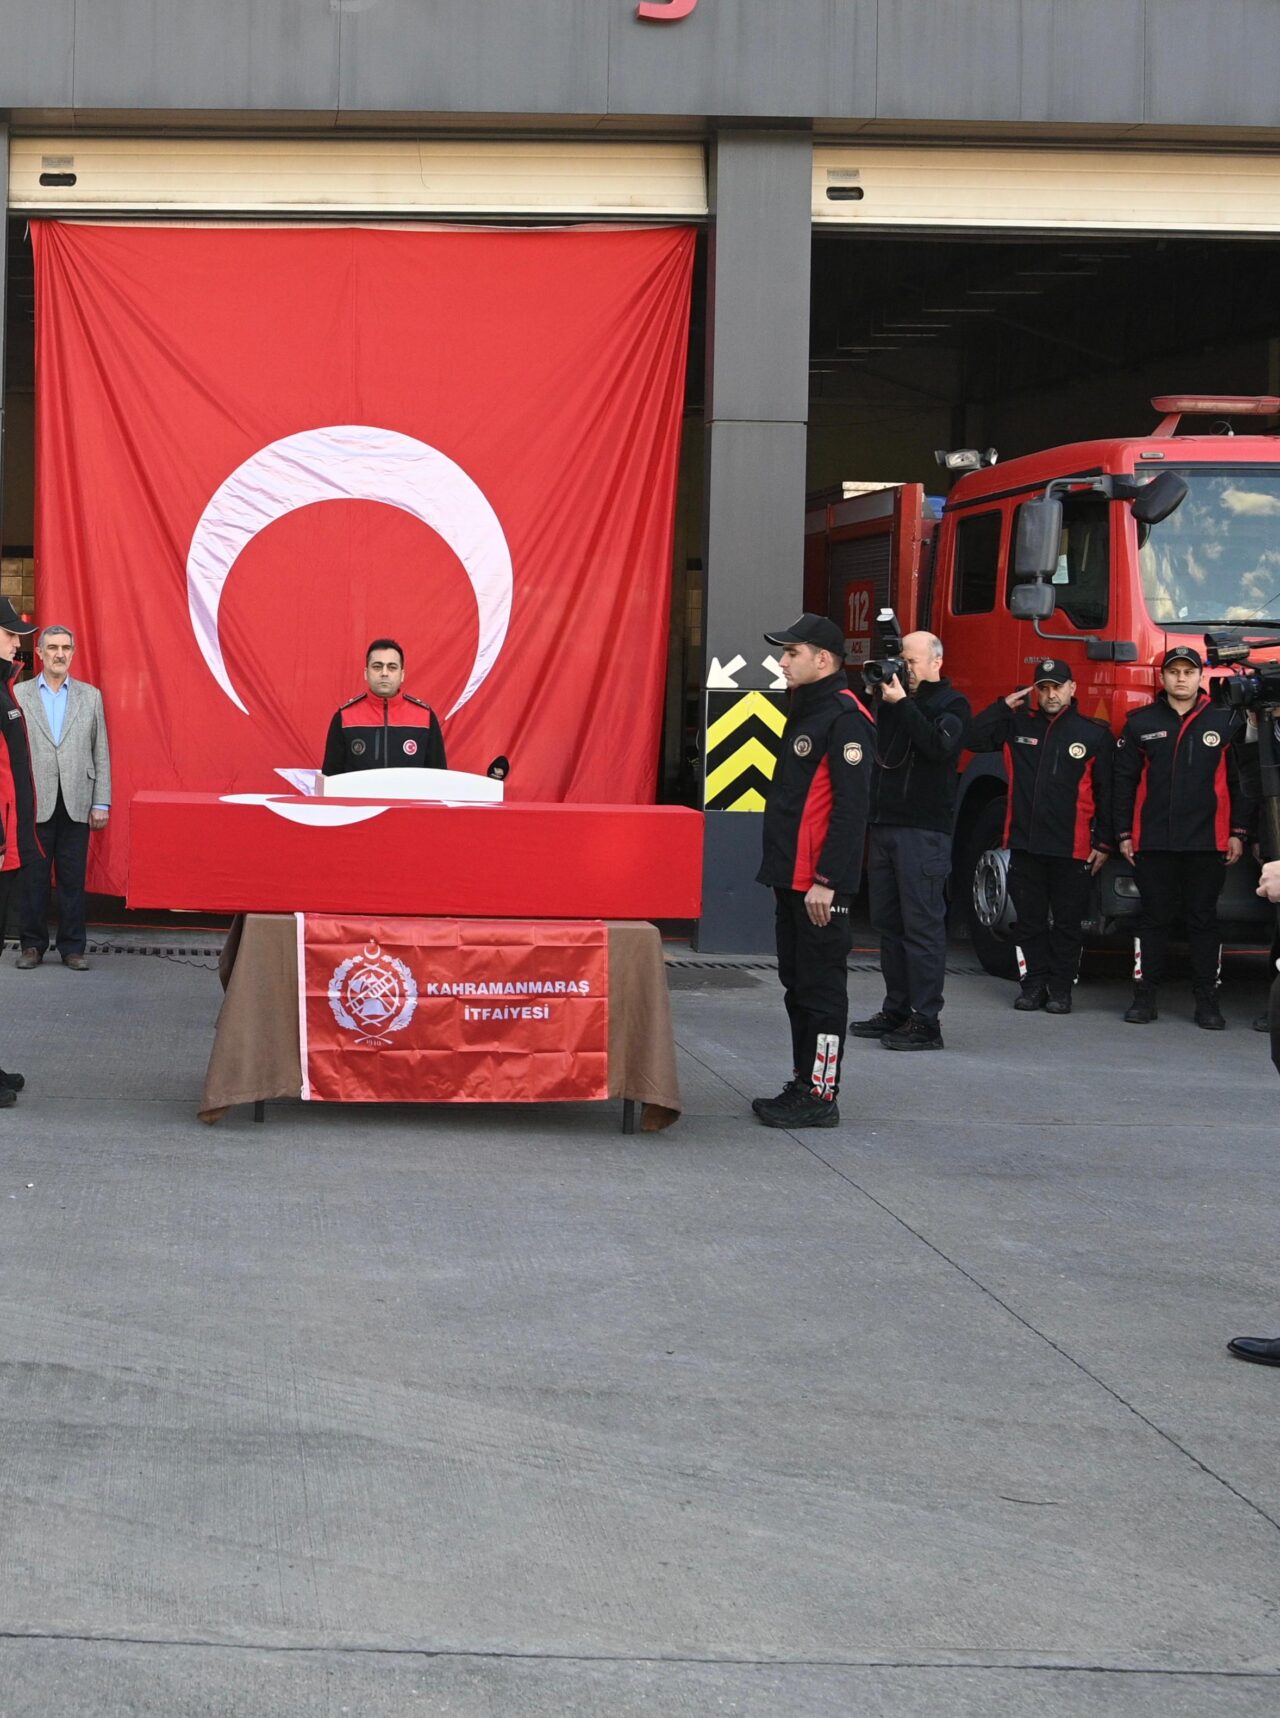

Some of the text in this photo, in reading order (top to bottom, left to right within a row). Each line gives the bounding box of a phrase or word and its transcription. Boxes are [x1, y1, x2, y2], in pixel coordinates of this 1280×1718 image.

[848, 591, 870, 631] 112
[426, 980, 591, 997] KAHRAMANMARAŞ
[463, 1004, 550, 1021] İTFAİYESİ
